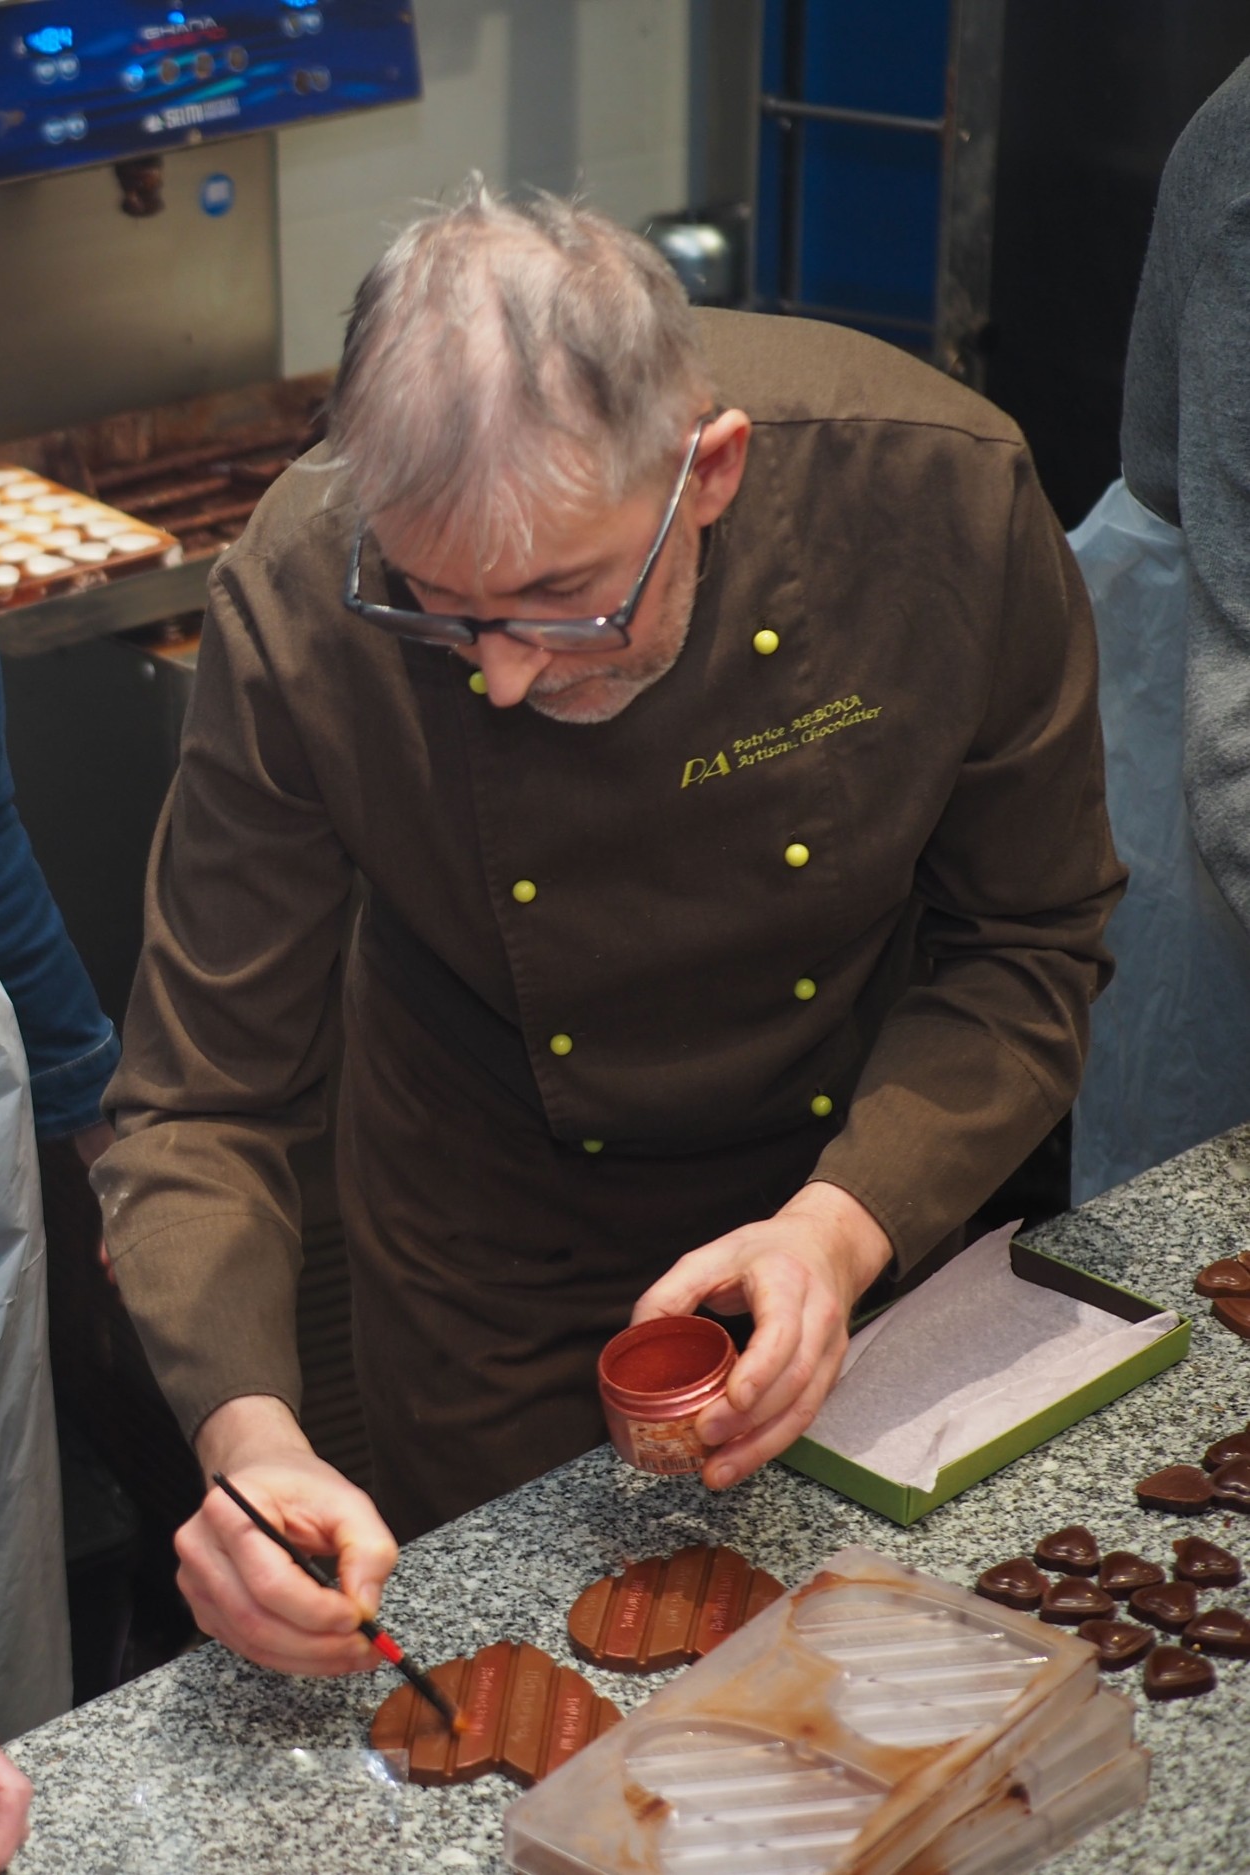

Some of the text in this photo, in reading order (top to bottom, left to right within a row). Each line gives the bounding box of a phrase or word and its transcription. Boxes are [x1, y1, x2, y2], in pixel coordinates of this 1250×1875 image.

[733, 726, 786, 753] Patrice
[737, 706, 883, 769] Artisan Chocolatier
[680, 751, 731, 789] PA
